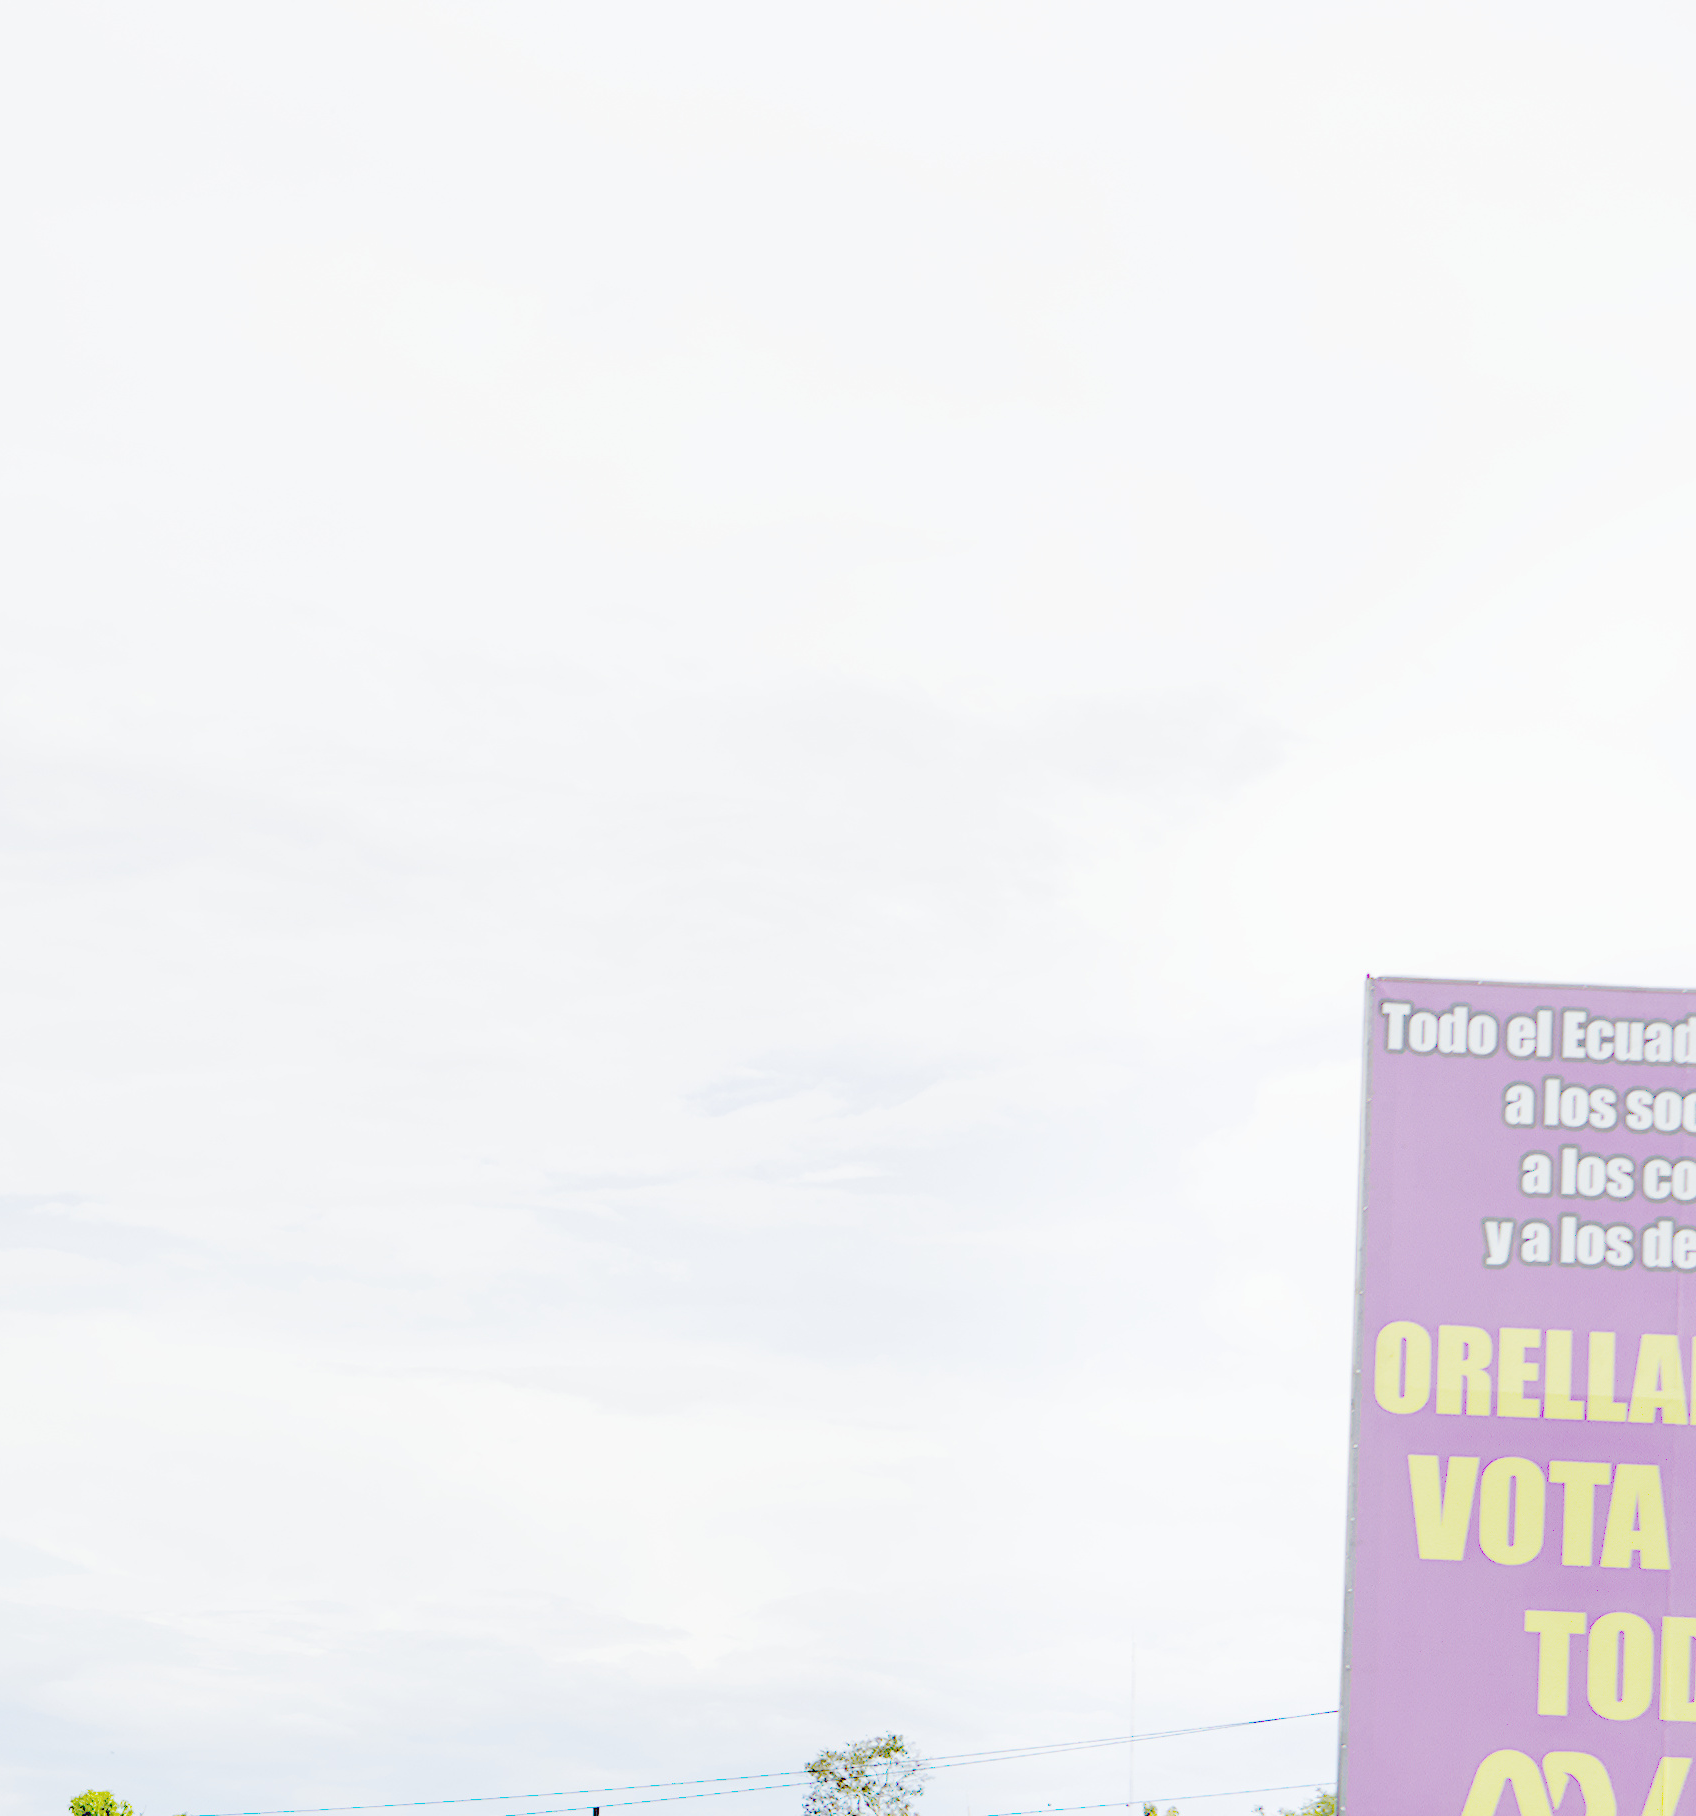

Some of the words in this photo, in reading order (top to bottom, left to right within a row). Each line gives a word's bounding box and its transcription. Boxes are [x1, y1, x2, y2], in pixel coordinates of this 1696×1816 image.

[1382, 1003, 1497, 1055] Todo
[1507, 1010, 1552, 1057] el
[1505, 1085, 1534, 1125] a
[1544, 1079, 1616, 1129] los
[1522, 1154, 1551, 1194] a
[1561, 1148, 1633, 1197] los
[1485, 1221, 1513, 1265] y
[1521, 1223, 1550, 1262] a
[1561, 1216, 1633, 1266] los
[1407, 1454, 1671, 1571] VOTA
